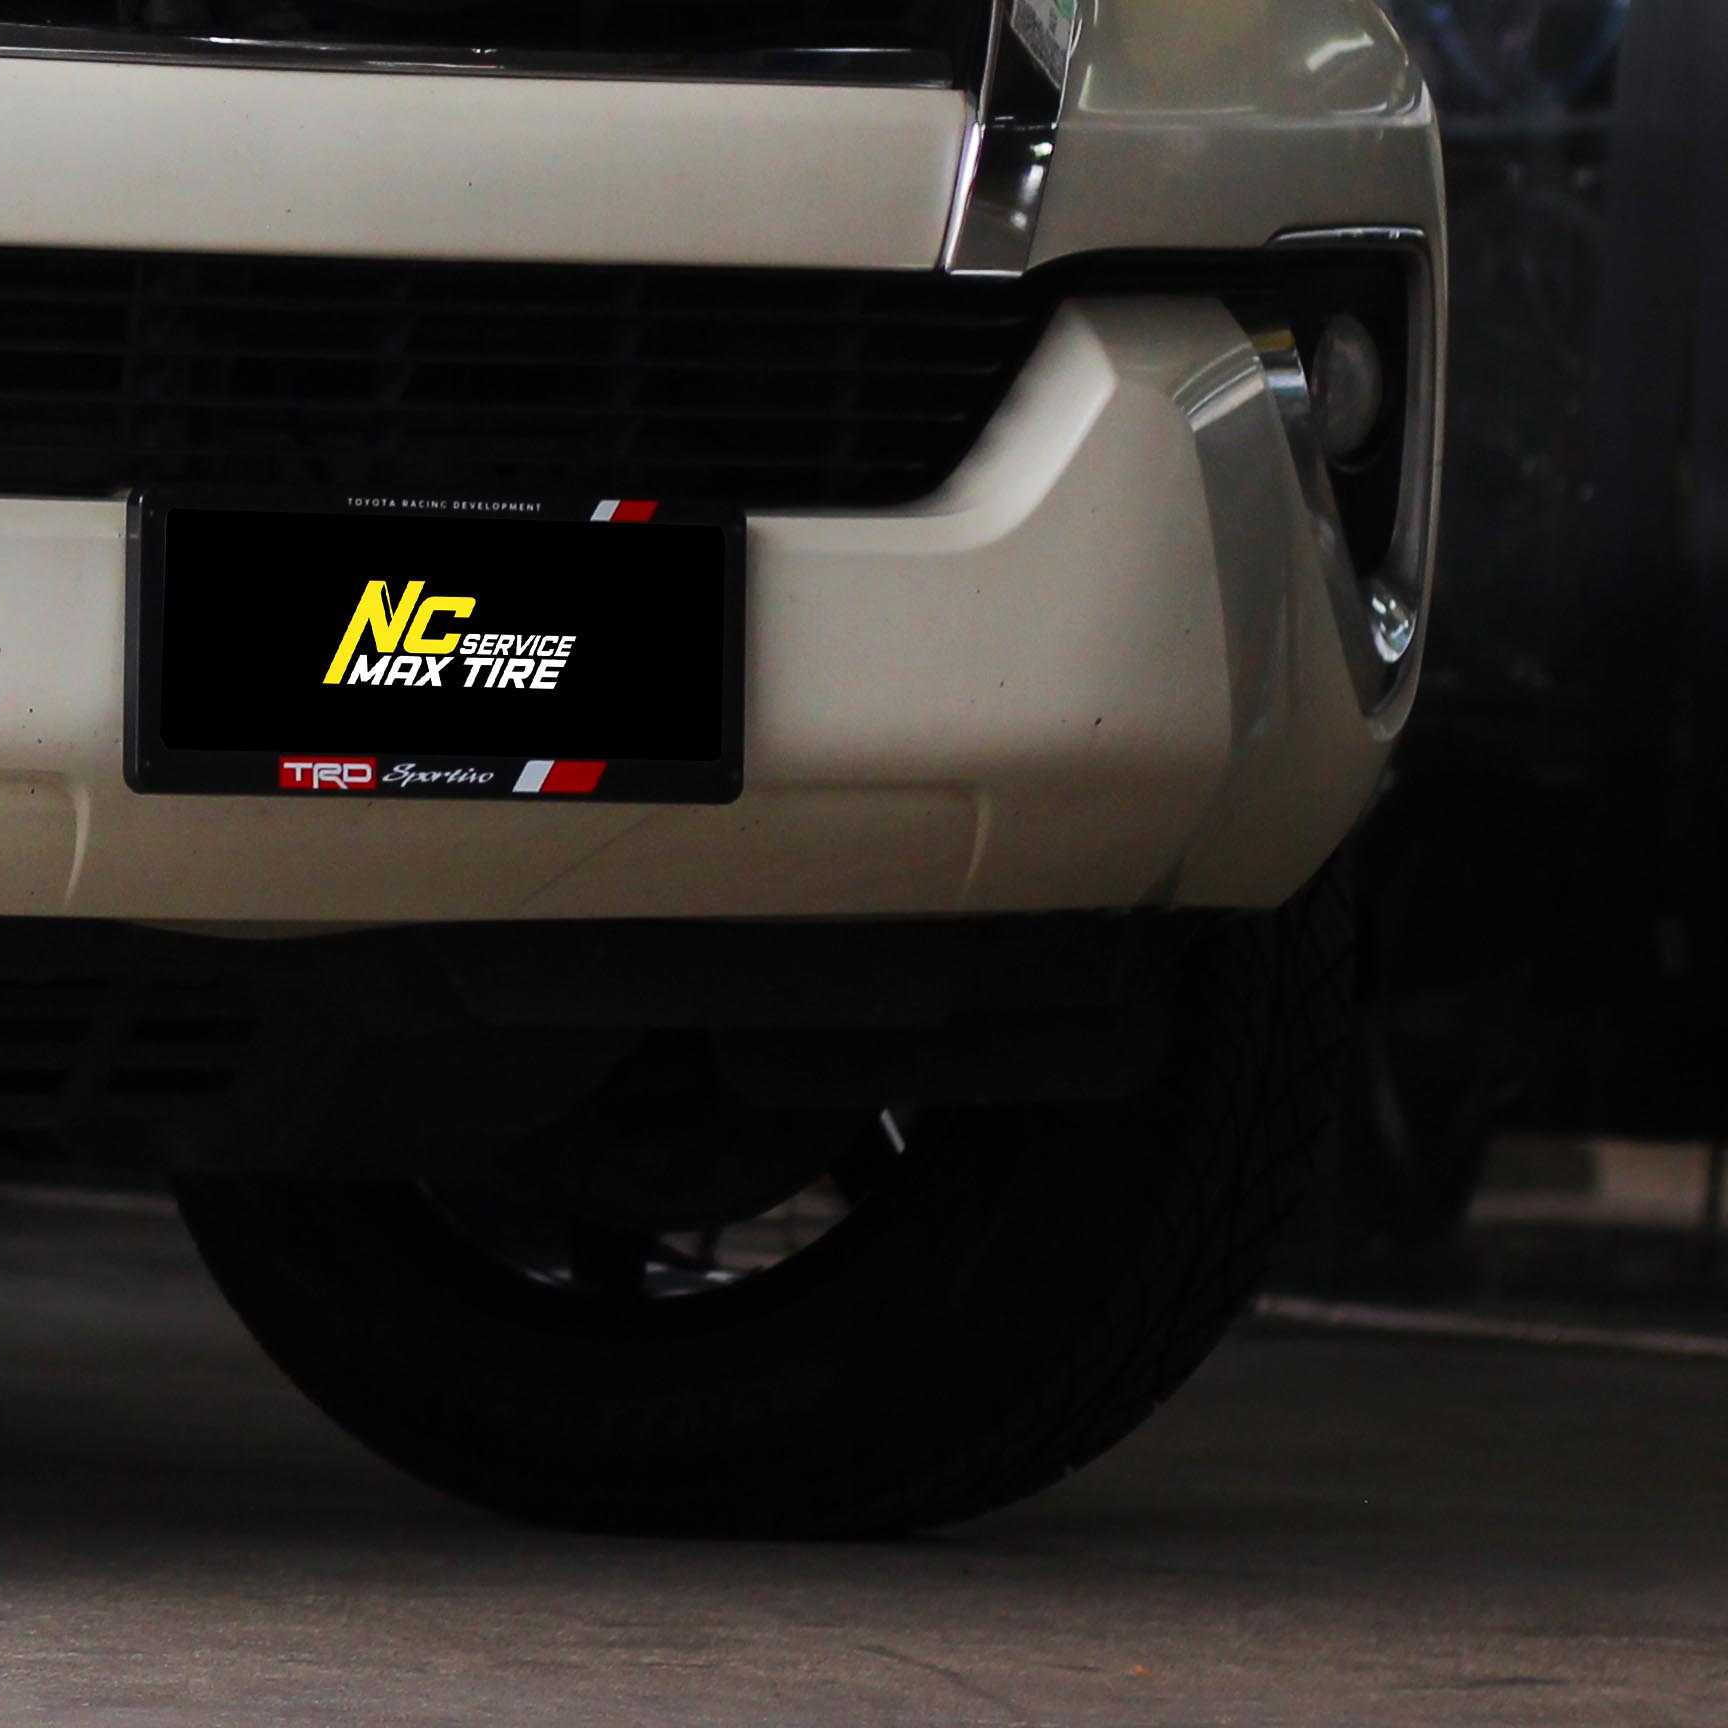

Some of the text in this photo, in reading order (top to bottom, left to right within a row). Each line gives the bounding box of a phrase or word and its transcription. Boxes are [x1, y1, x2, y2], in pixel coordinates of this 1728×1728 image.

[347, 497, 542, 512] TOYOTA RACING DEVELOPMENT
[283, 762, 494, 790] TRD Sportivo
